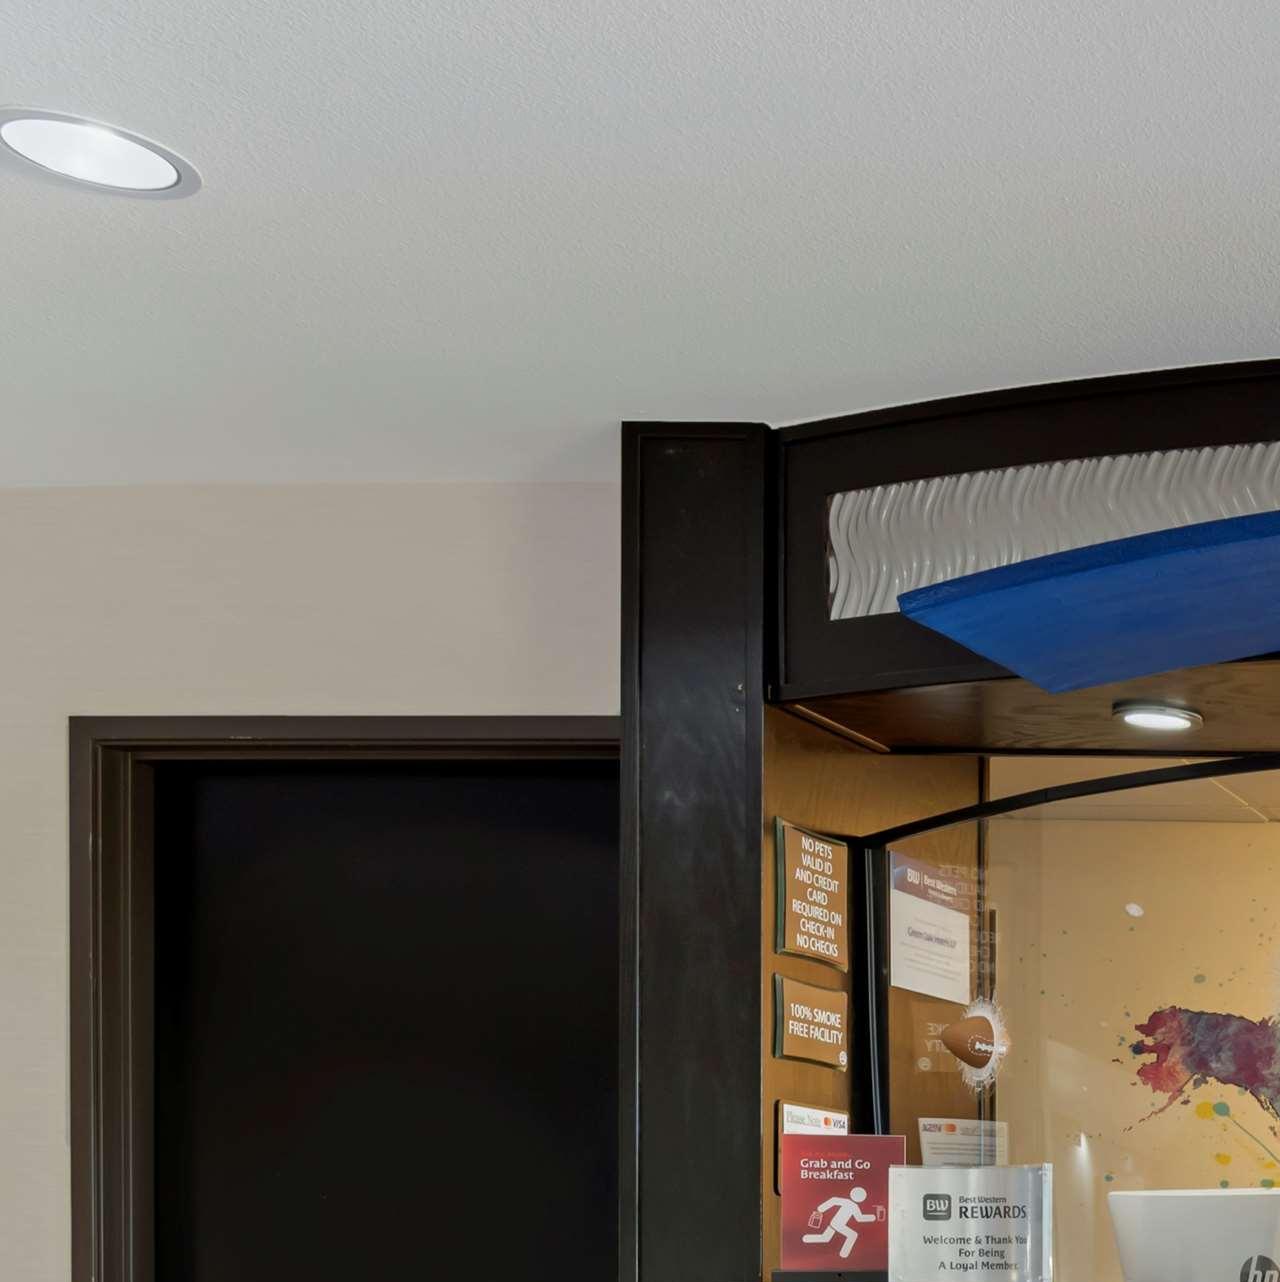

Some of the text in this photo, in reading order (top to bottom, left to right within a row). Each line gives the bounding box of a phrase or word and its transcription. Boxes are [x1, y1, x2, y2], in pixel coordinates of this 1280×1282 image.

[801, 836, 833, 859] NO PETS
[801, 853, 833, 875] VALID ID
[795, 867, 839, 894] AND CREDIT
[807, 888, 828, 905] CARD
[792, 899, 842, 927] REQUIRED ON
[800, 918, 835, 940] CHECK-IN
[796, 933, 839, 957] NO CHECKS
[790, 1003, 841, 1028] 100% SMOKE
[788, 1020, 843, 1045] FREE FACILITY
[800, 1158, 871, 1169] Grab and Go
[800, 1169, 855, 1180] Breakfast
[926, 1199, 949, 1211] BW
[959, 1195, 1007, 1204] Best Western
[958, 1205, 1027, 1219] REWARDS
[923, 1235, 972, 1245] Welcome
[974, 1236, 982, 1245] &
[984, 1235, 1013, 1245] Thank
[958, 1248, 1006, 1259] For Being
[938, 1261, 1019, 1272] A Loyal Member
